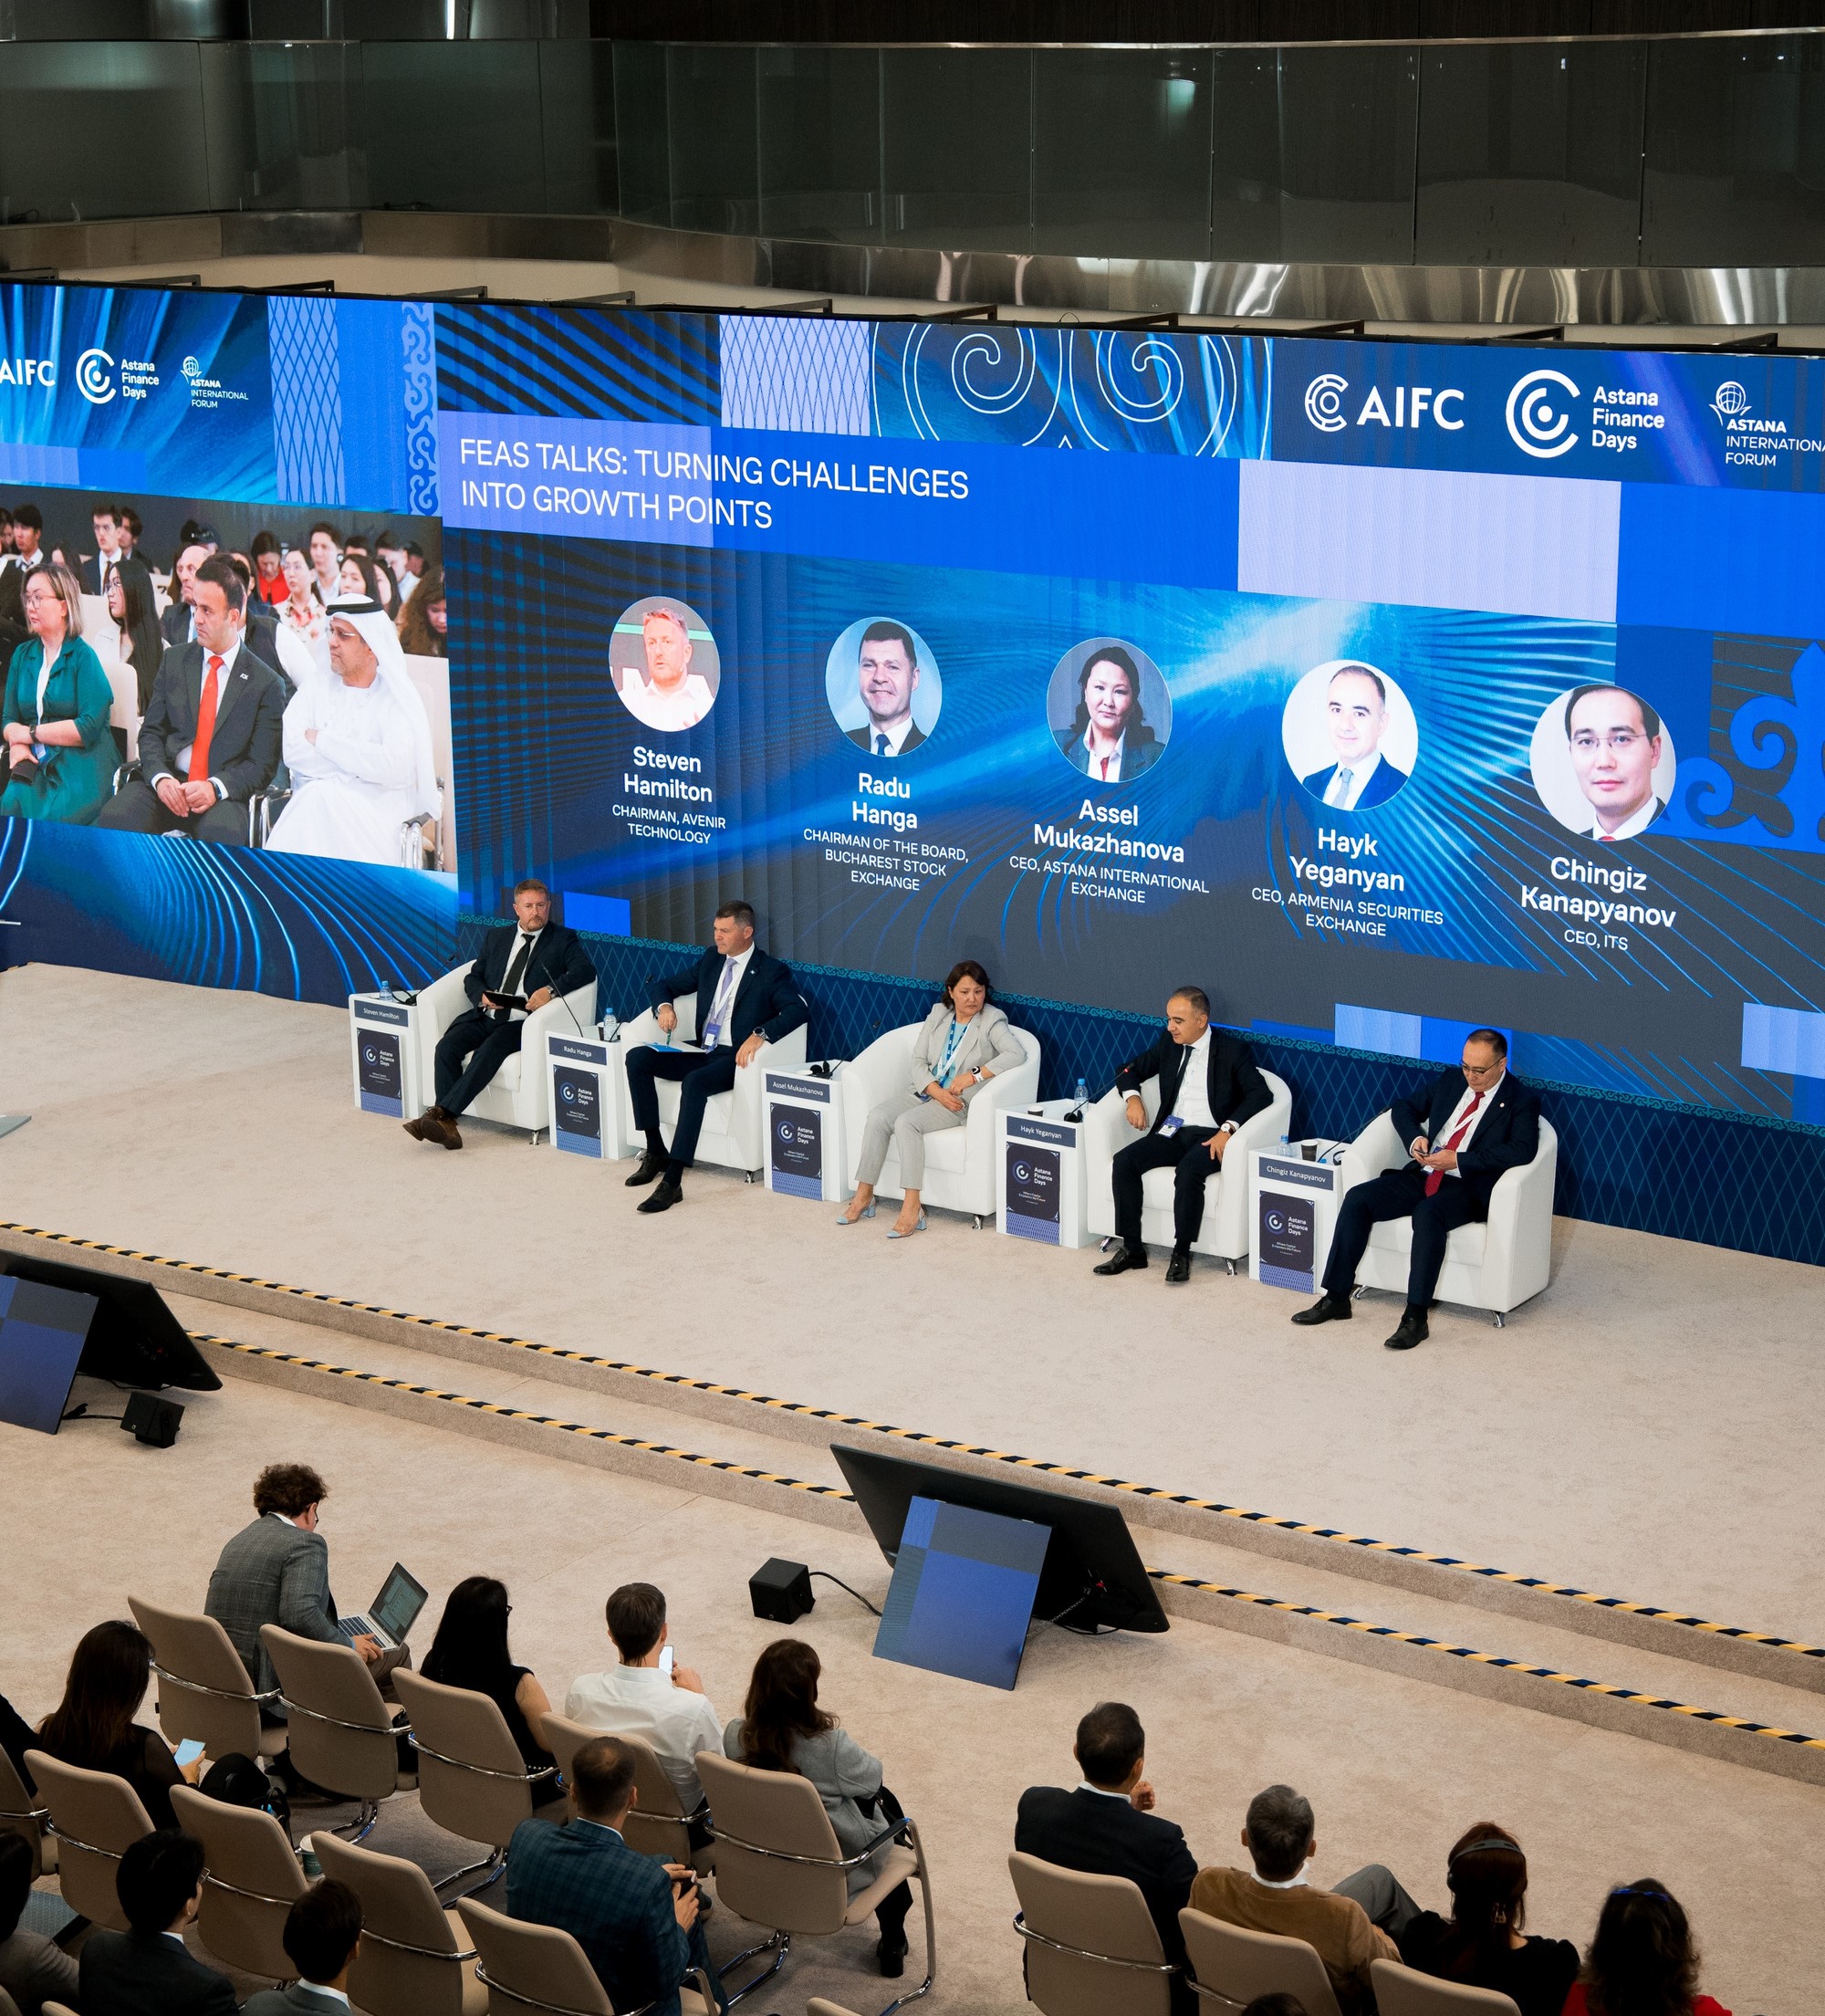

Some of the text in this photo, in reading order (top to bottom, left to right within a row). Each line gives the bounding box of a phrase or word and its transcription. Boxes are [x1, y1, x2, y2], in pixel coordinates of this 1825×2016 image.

[0, 359, 56, 386] AIFC
[121, 359, 155, 372] Astana
[122, 372, 159, 386] Finance
[190, 379, 221, 388] ASTANA
[123, 386, 146, 400] Days
[191, 390, 249, 401] INTERNATIONAL
[192, 399, 218, 408] FORUM
[1593, 386, 1658, 406] Astana
[1357, 386, 1465, 430] AIFC
[1593, 408, 1665, 429] Finance
[1727, 419, 1786, 433] ASTANA
[1592, 430, 1637, 452] Days
[461, 439, 969, 500] FEAS TALKS: TURNING CHALLENGES
[1726, 453, 1776, 466] FORUM
[462, 480, 772, 529] INTO GROWTH POINTS
[633, 746, 701, 773] Steven
[624, 773, 712, 803] Hamilton
[859, 773, 910, 799] Radu
[612, 804, 726, 829] CHAIRMAN, AVENIR
[852, 801, 918, 832] Hanga
[1079, 799, 1138, 826] Assel
[627, 823, 711, 844] TECHNOLOGY
[1034, 823, 1184, 863] Mukazhanova
[1318, 827, 1378, 858] Hayk
[803, 829, 969, 863] CHAIRMAN OF THE BOARD,
[825, 849, 946, 876] BUCHAREST STOCK
[851, 870, 920, 891] EXCHANGE
[1010, 856, 1210, 893] CEO, ASTANA INTERNATIONAL
[1290, 857, 1405, 893] Yeganyan
[1551, 857, 1647, 893] Chingiz
[1071, 882, 1146, 903] EXCHANGE
[1251, 887, 1444, 925] CEO, ARMENIA SECURITIES
[1521, 885, 1676, 928] Kanapyanov
[1306, 914, 1387, 937] EXCHANGE
[1564, 929, 1628, 951] CEO, ITS
[364, 1008, 399, 1020] Steven Hamilton
[564, 1046, 592, 1057] Radu Hanga
[773, 1081, 823, 1095] Assel Mukazhanova
[1021, 1125, 1062, 1139] Hayk Yeganyan
[1034, 1172, 1053, 1182] Finance
[1267, 1165, 1326, 1182] Chingiz Kanapyanov
[1288, 1217, 1306, 1225] Astana
[1288, 1222, 1308, 1231] Finance
